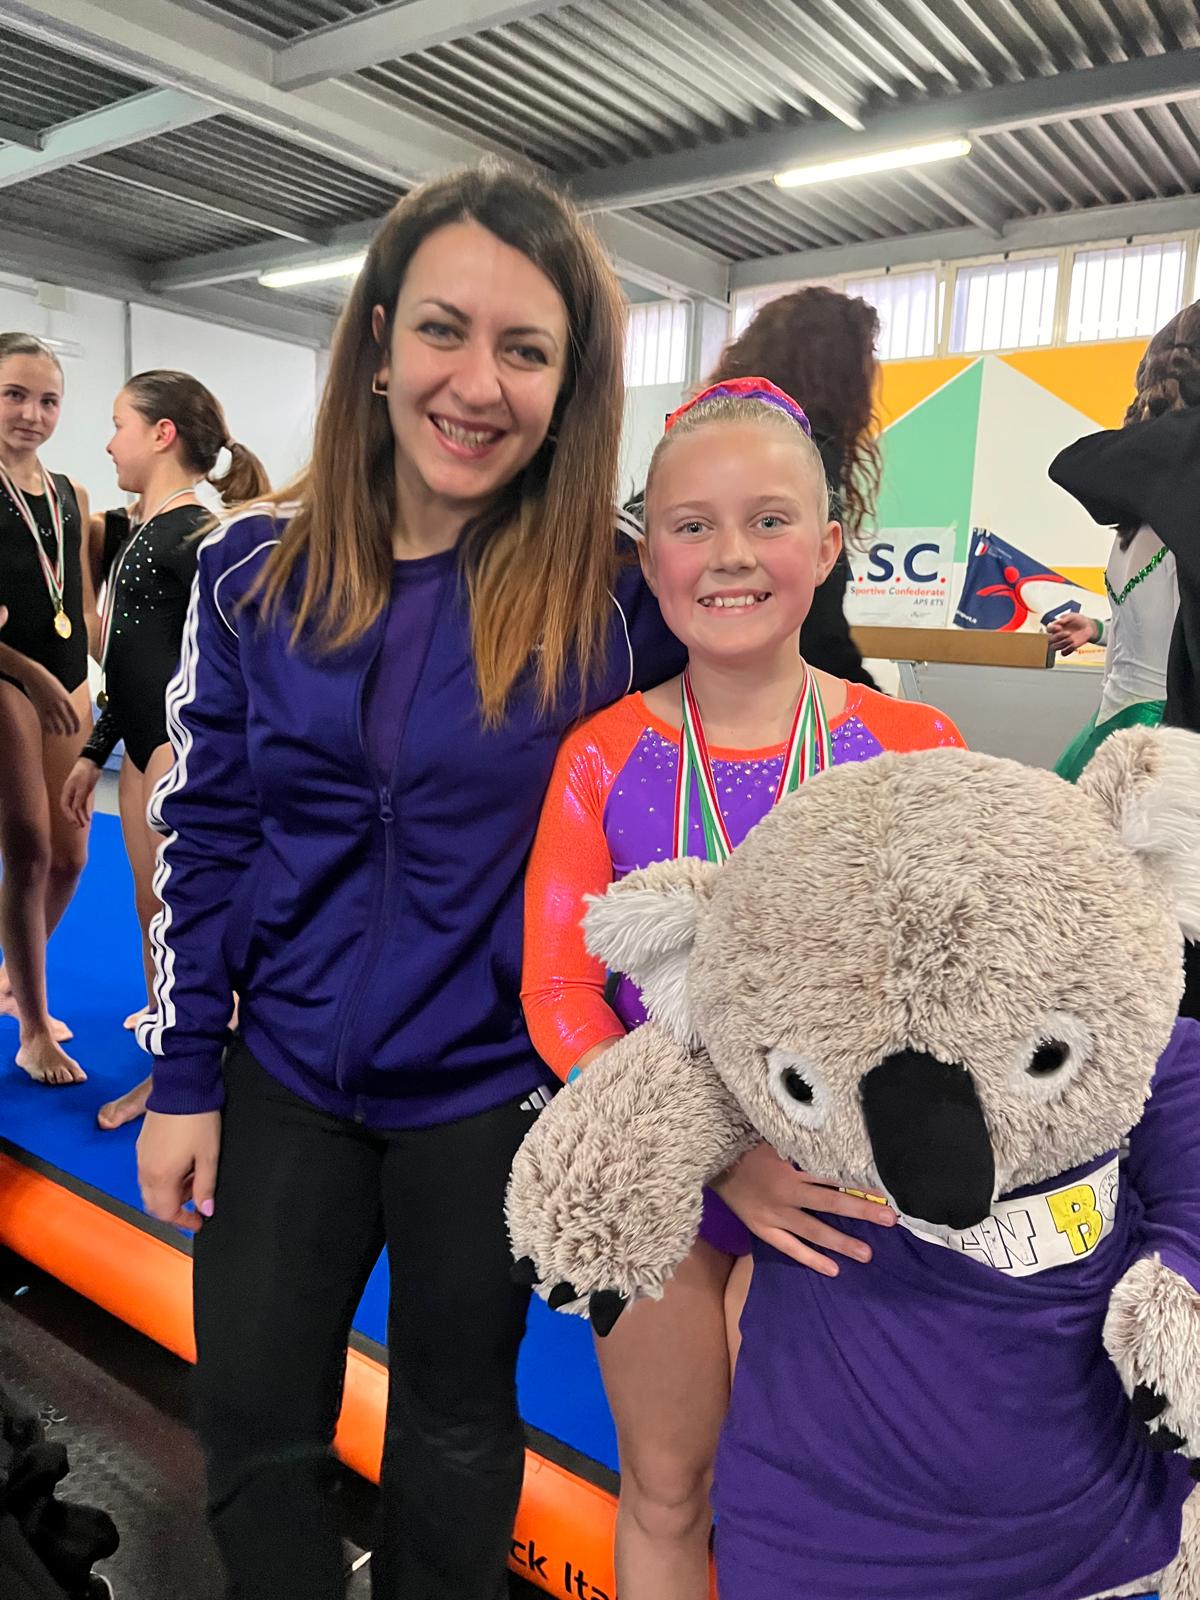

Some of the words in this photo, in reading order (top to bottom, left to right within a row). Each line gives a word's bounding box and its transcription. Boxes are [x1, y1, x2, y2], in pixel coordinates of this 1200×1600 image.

[847, 543, 946, 583] .S.C.
[850, 586, 886, 597] Sportive
[888, 586, 945, 597] Confederate
[913, 598, 928, 606] APS
[930, 599, 944, 607] ETS
